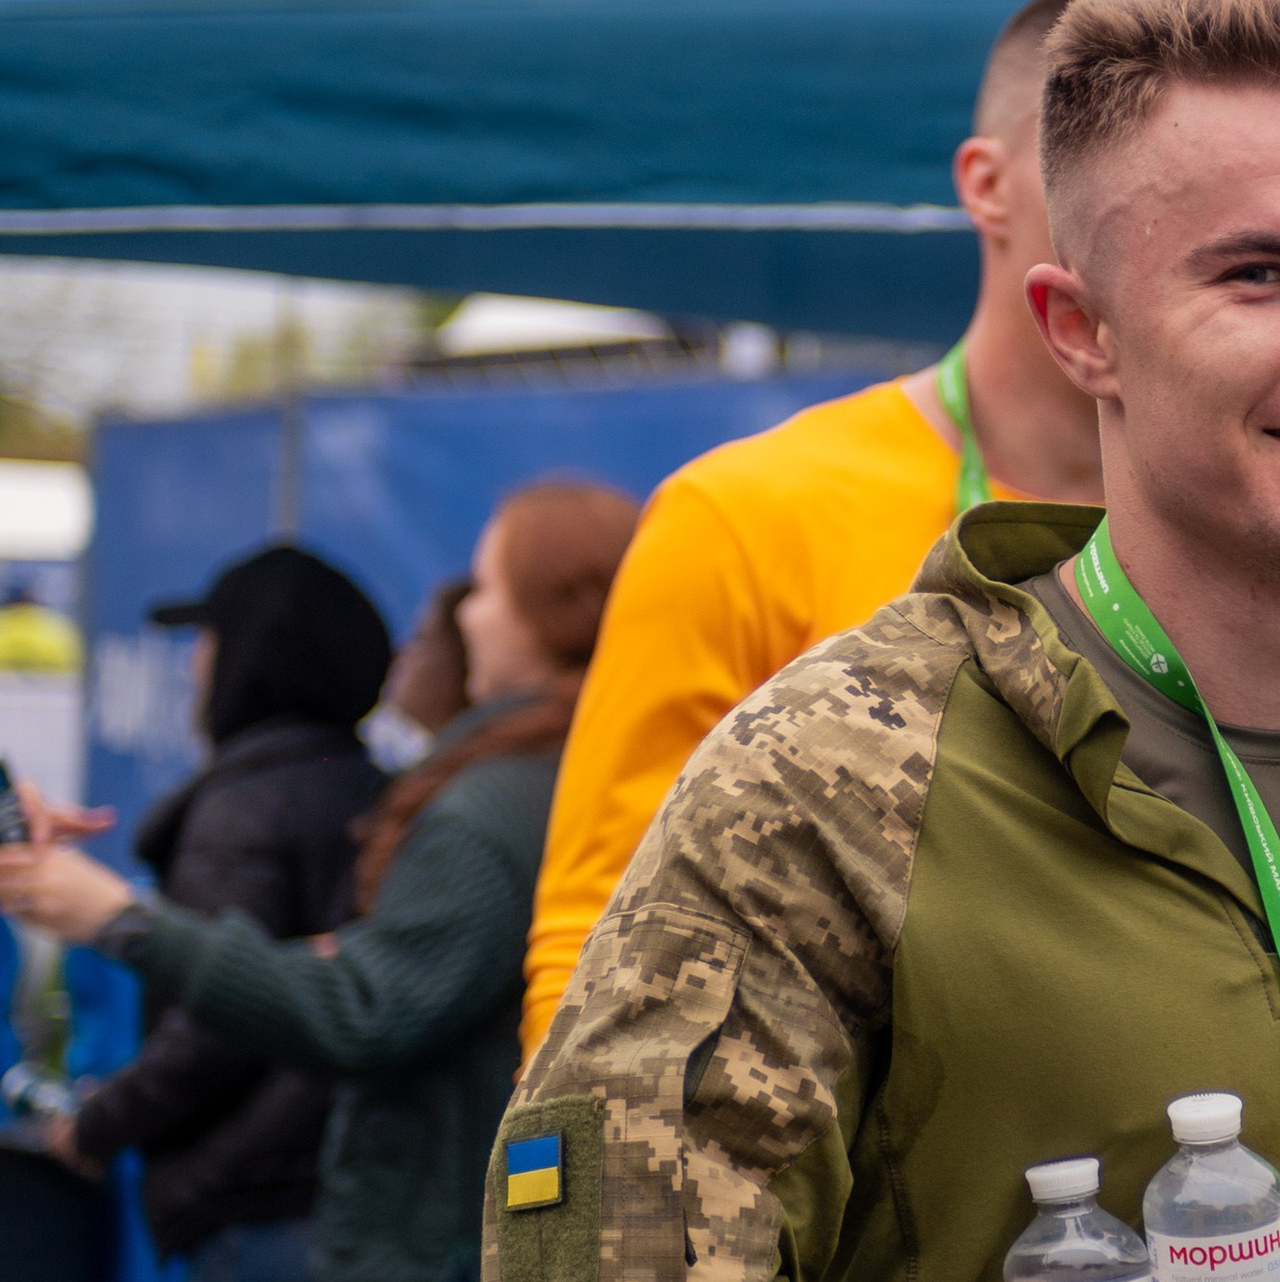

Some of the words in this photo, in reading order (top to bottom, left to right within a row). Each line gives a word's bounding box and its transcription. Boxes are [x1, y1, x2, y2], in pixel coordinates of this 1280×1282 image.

[1241, 783, 1275, 863] КИЇВСЬКИЙ
[1204, 1272, 1238, 1282] mineral
[1241, 1268, 1264, 1279] water
